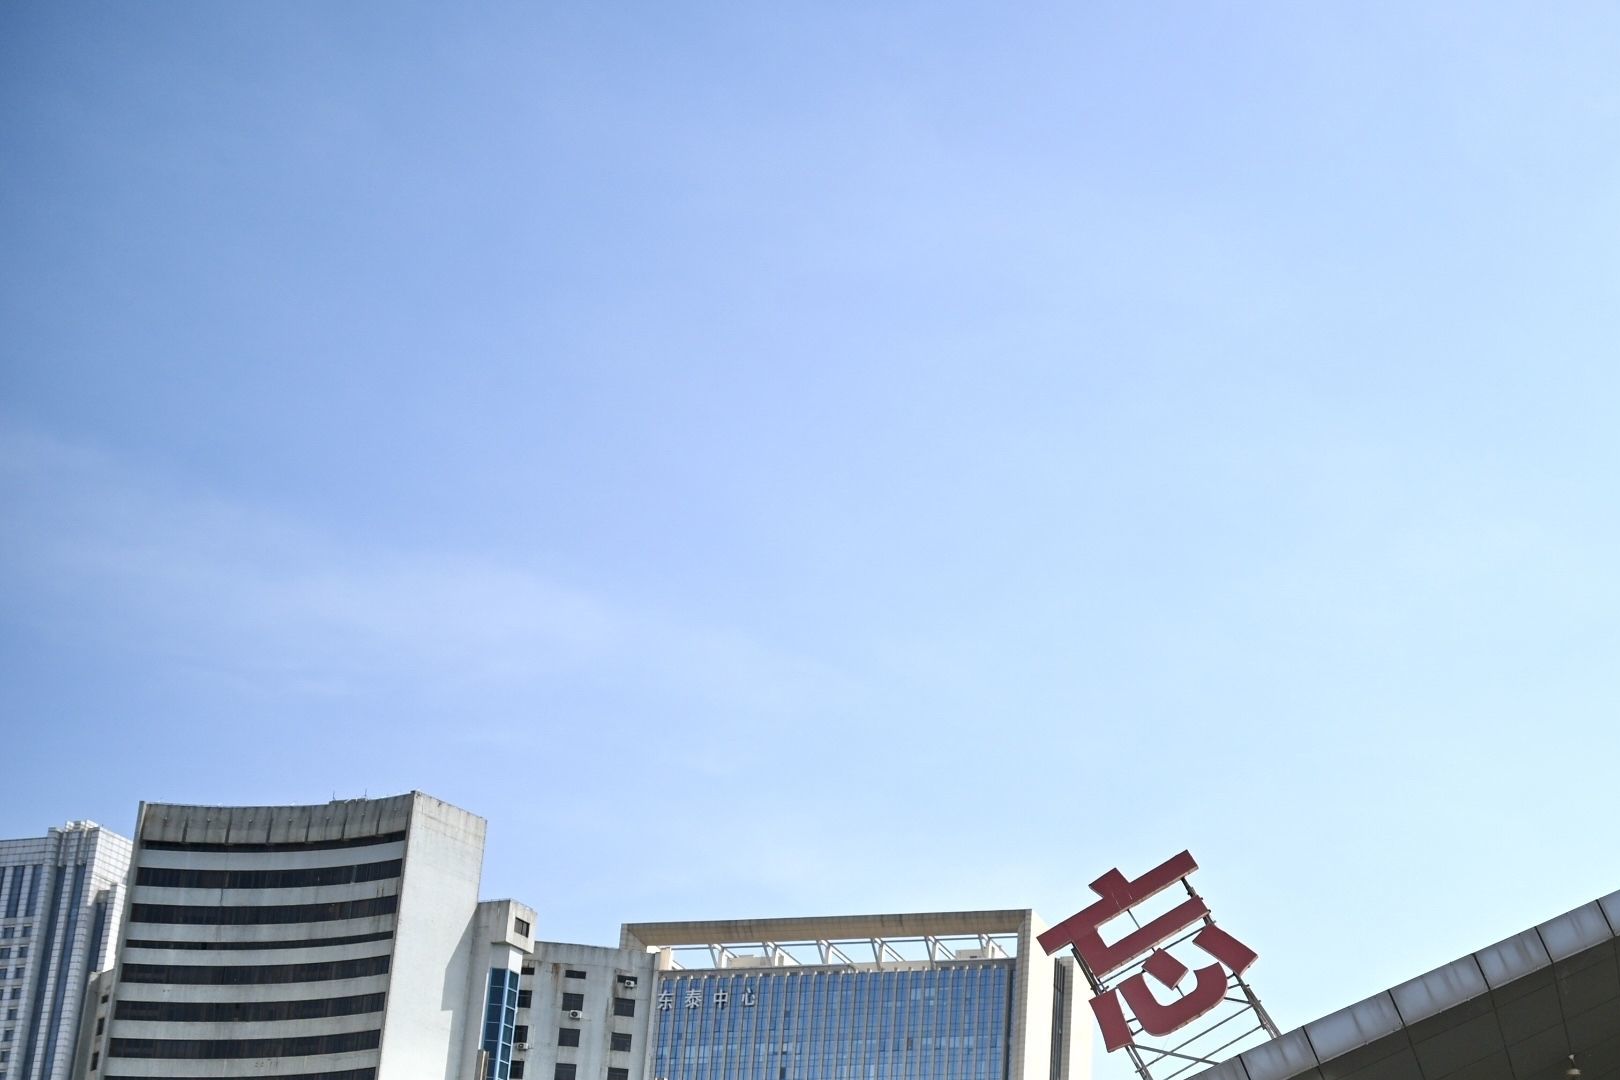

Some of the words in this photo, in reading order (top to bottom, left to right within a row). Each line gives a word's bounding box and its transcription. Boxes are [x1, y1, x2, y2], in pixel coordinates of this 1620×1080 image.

[657, 988, 756, 1011] 东泰中心
[1037, 849, 1259, 1054] 忘
